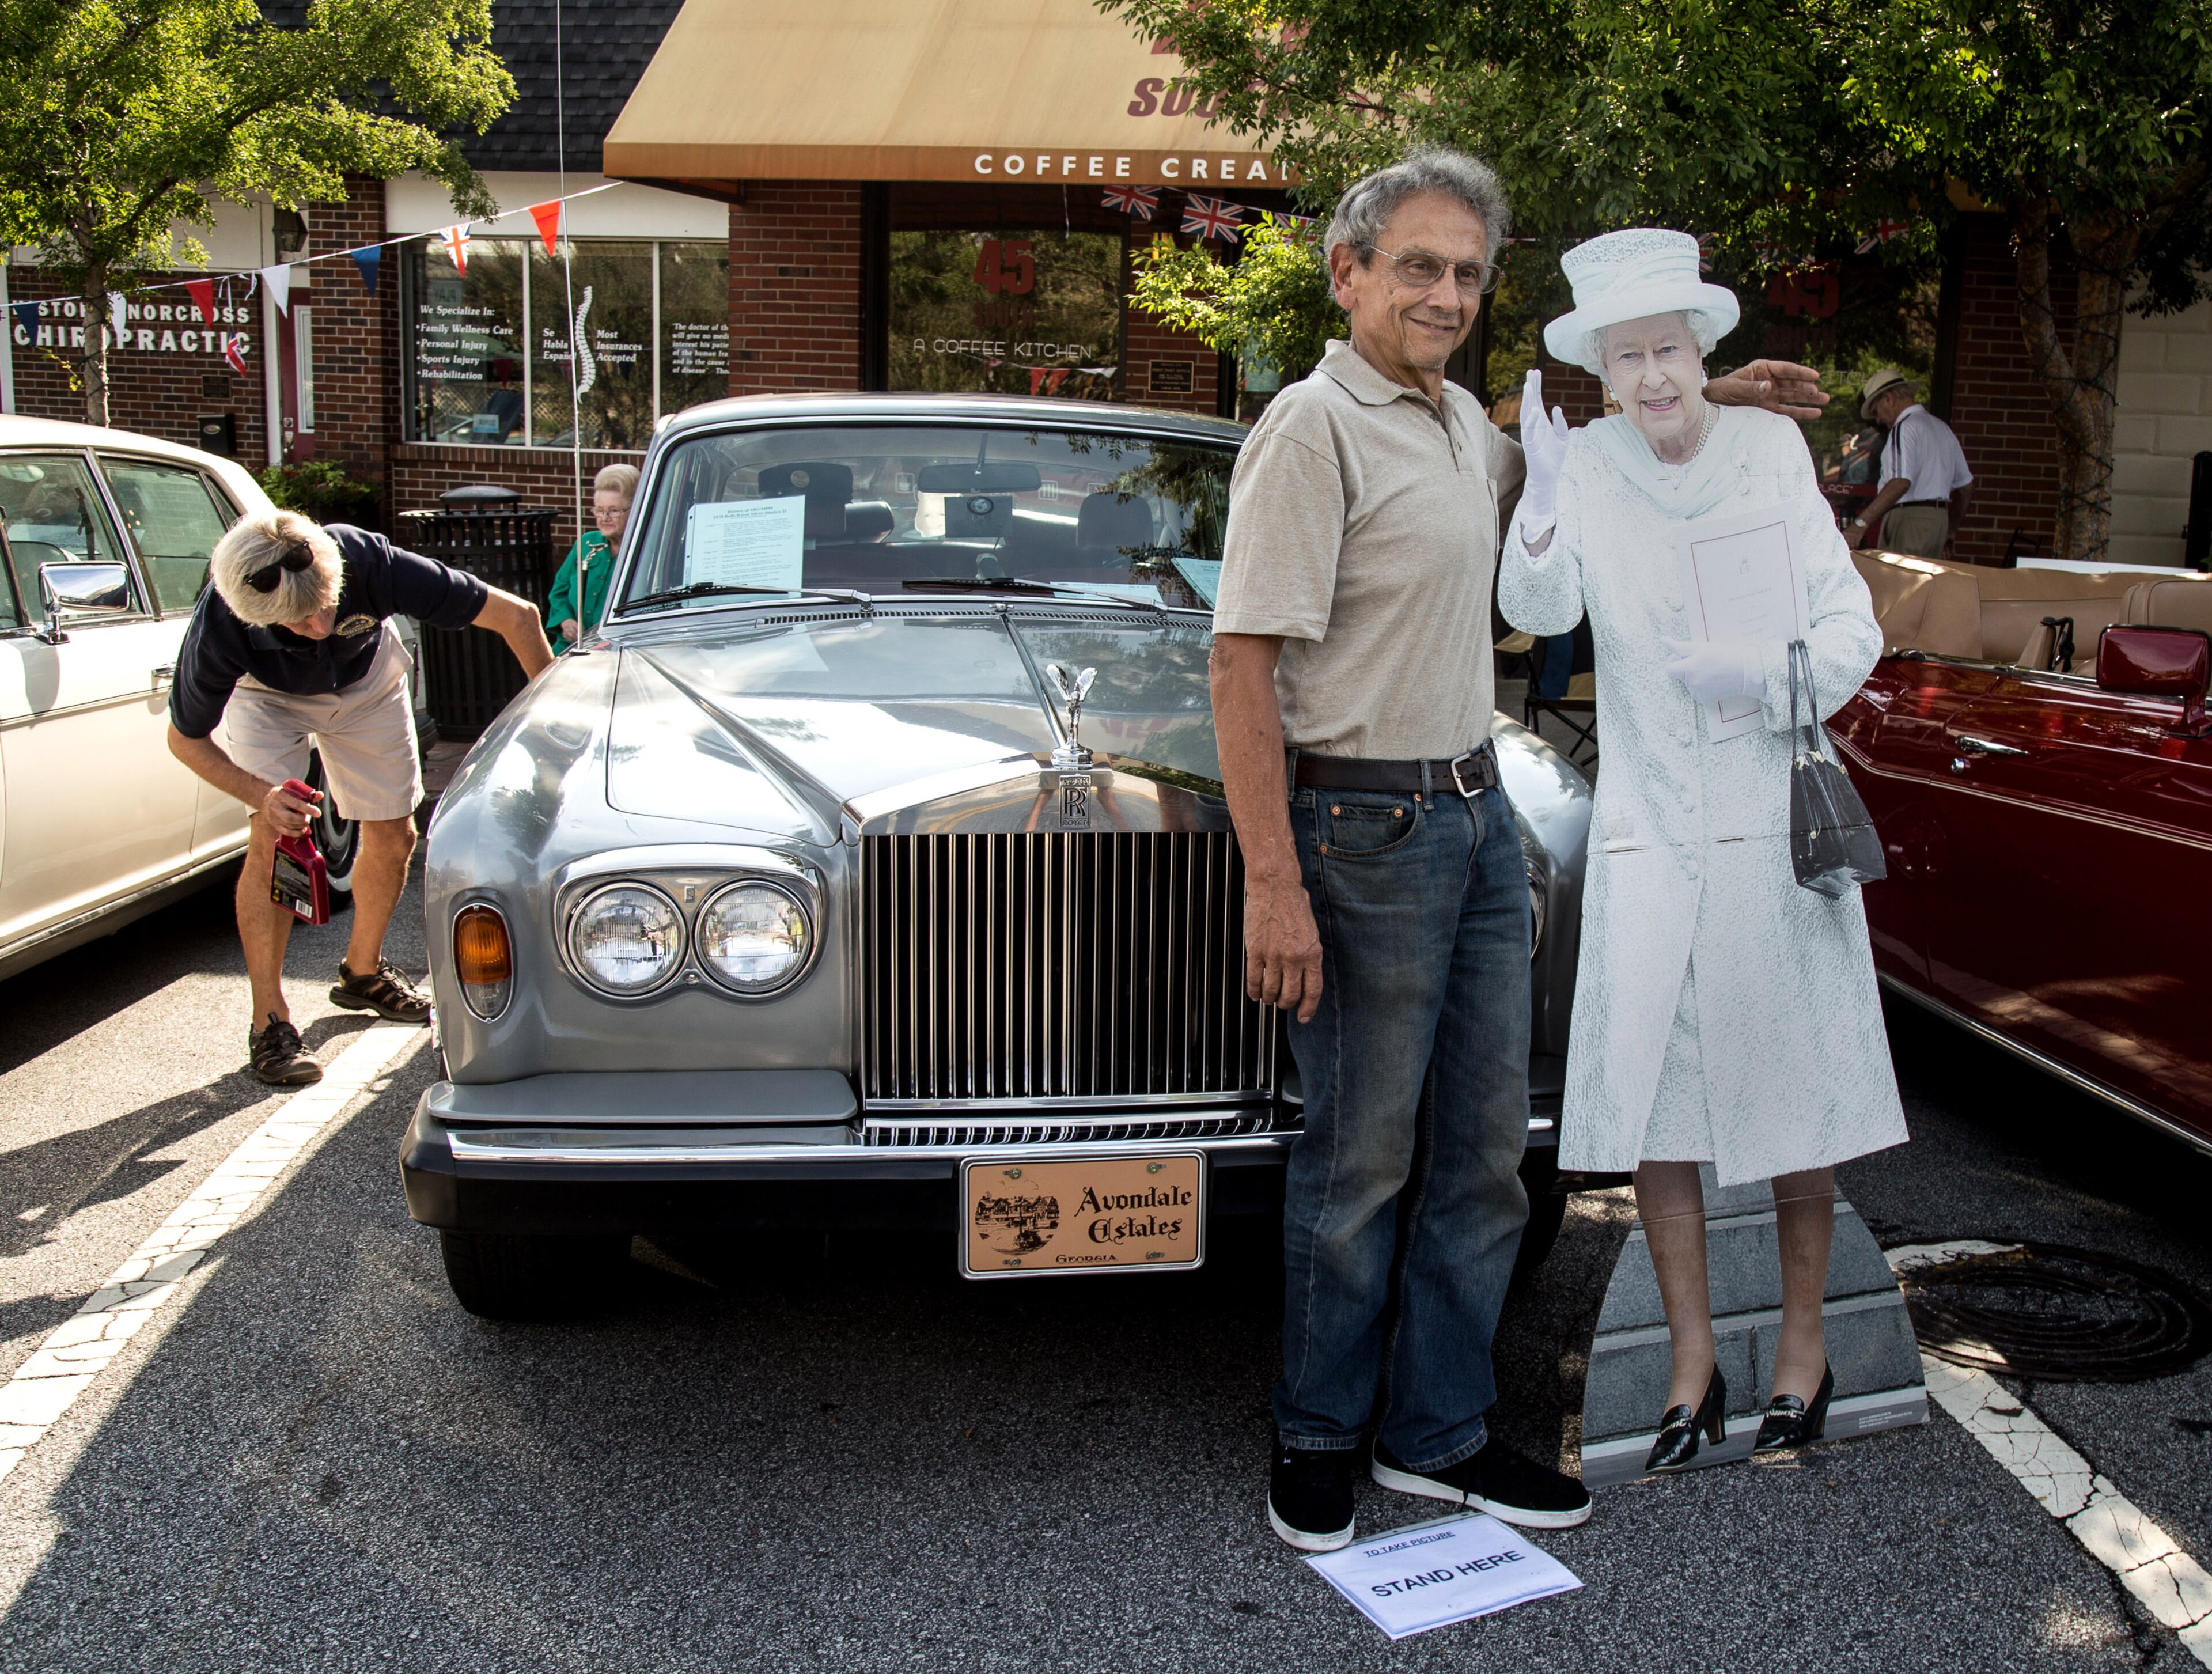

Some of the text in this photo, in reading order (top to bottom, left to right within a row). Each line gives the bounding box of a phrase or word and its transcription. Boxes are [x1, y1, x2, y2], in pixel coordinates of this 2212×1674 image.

[974, 154, 1131, 177] COFFEE
[974, 239, 1035, 295] 45
[420, 305, 495, 316] We Specialize In:
[420, 323, 514, 335] Family Wellness Care
[543, 328, 555, 338] Se
[596, 329, 618, 339] Most
[421, 339, 488, 351] Personal Injury
[543, 340, 569, 349] Habla
[596, 341, 643, 351] Insurances
[913, 338, 1092, 359] A COFFEE KITCHEN
[421, 354, 480, 366] Sports Injury
[596, 353, 637, 363] Accepted
[421, 369, 483, 380] Rehabilitation
[1073, 1185, 1192, 1218] Avondale
[1088, 1214, 1183, 1245] Estates
[1055, 1254, 1118, 1264] GEORGIA
[1363, 1531, 1456, 1558] TO TAKE PICTURE
[1371, 1550, 1526, 1597] STAND HERE
